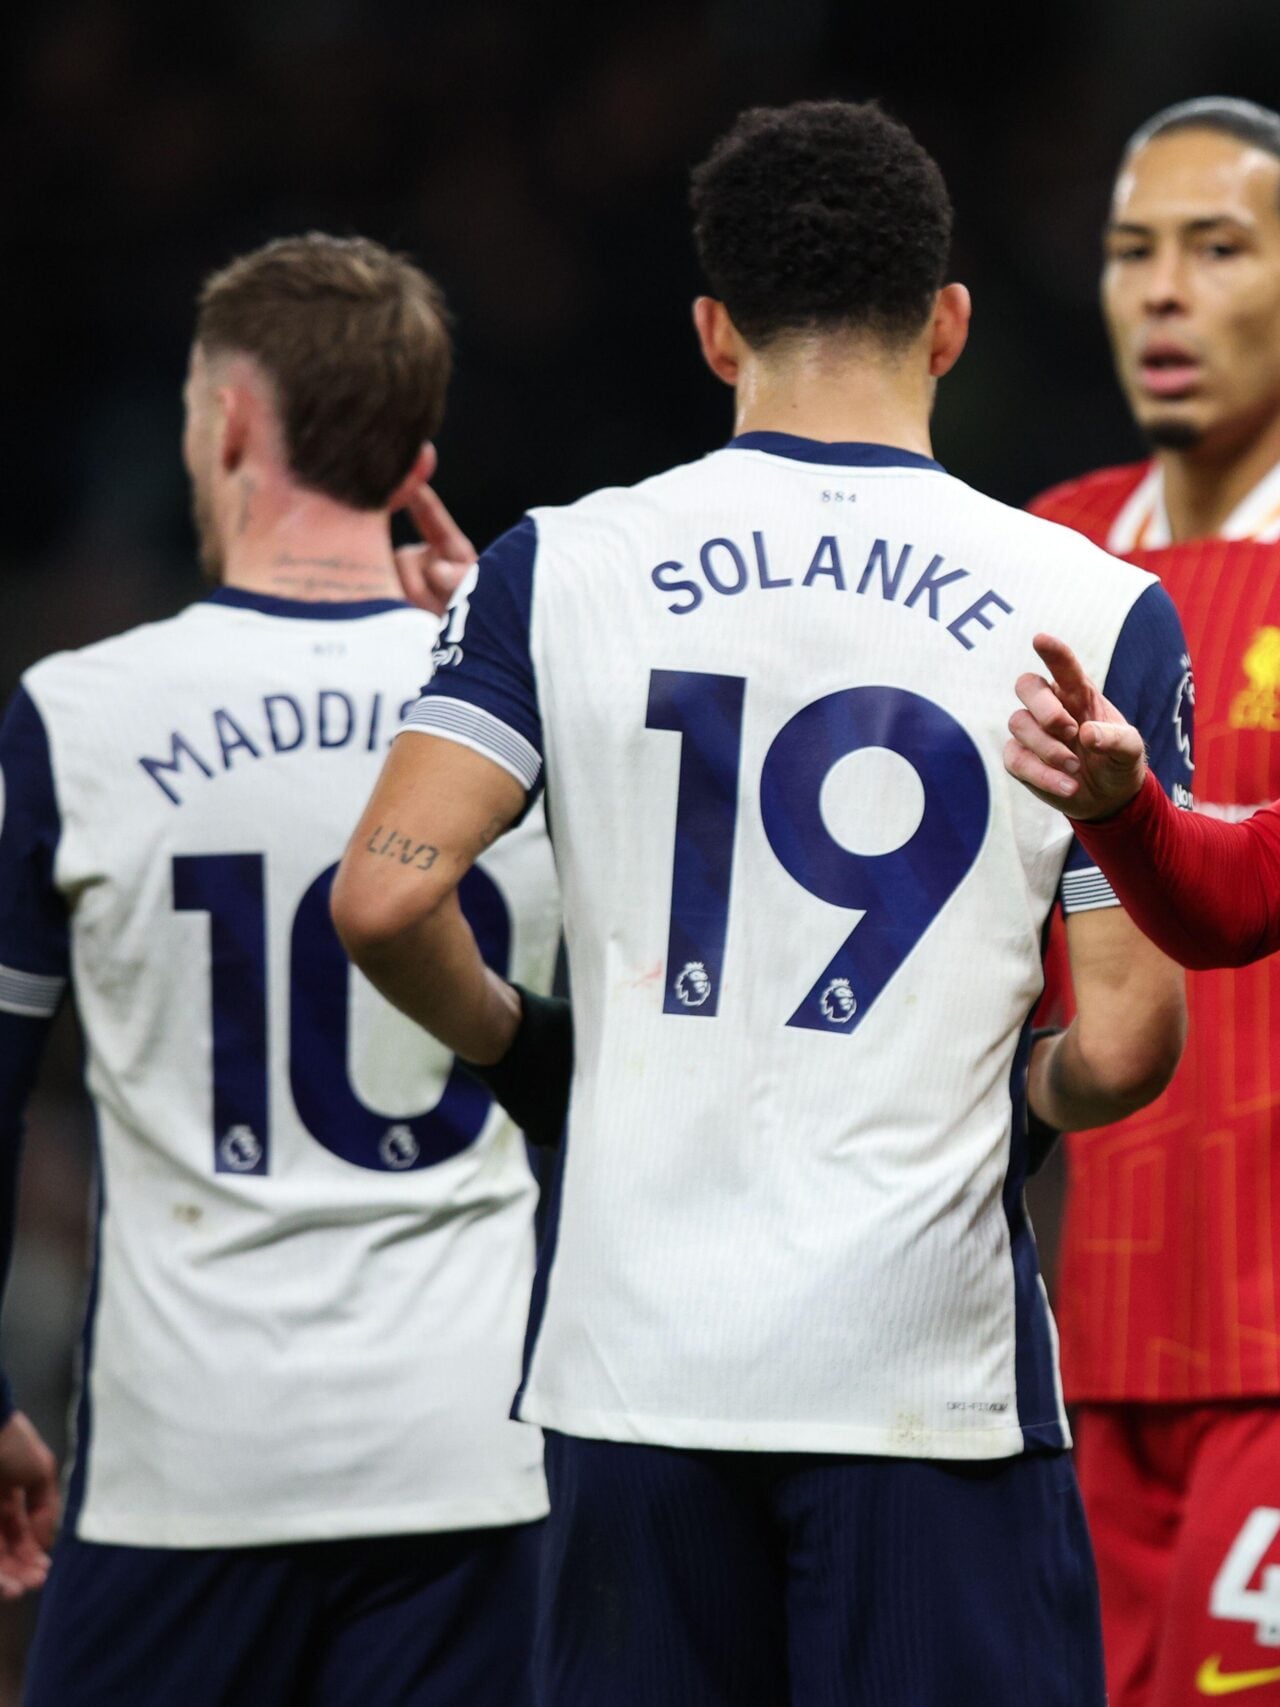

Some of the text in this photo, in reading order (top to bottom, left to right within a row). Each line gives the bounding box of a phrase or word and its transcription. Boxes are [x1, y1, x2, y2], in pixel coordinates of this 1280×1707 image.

[651, 531, 1014, 650] SOLANKE
[645, 668, 990, 1035] 19
[171, 852, 512, 1176] 10
